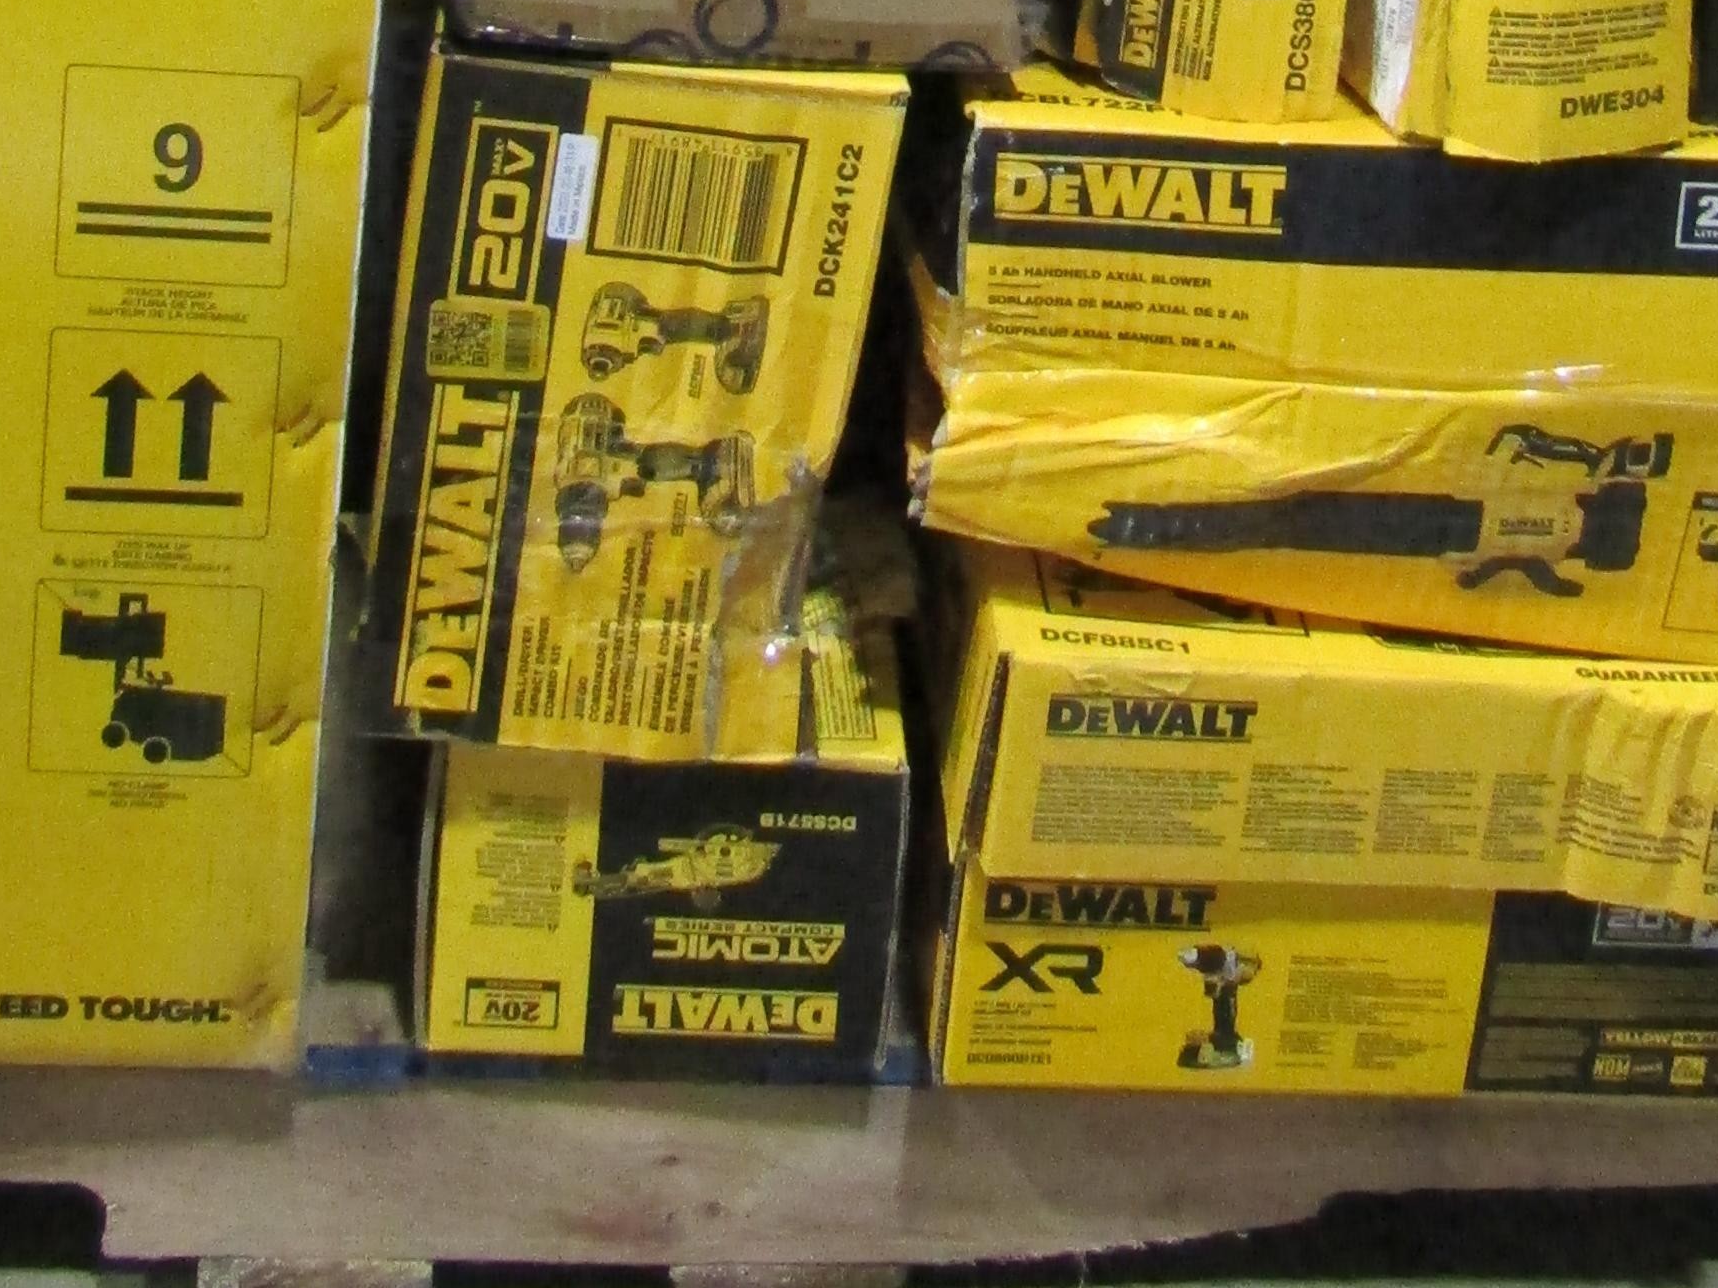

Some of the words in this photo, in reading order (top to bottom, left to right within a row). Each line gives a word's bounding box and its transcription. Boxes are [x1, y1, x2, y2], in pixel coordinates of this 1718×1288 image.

[1560, 85, 1665, 119] DWE304
[153, 122, 205, 193] 9
[995, 162, 1286, 226] DEWALT
[814, 143, 865, 298] DCK241C2
[1023, 267, 1102, 281] HANDHELD
[1105, 271, 1146, 284] AXIAL
[1151, 274, 1212, 288] BLOWER
[406, 383, 512, 712] DEWALT
[1039, 627, 1191, 655] DCF885C1
[1046, 697, 1258, 739] DEWALT
[985, 884, 1216, 927] DEWALT
[653, 936, 845, 964] ATOMIC
[979, 941, 1106, 994] XR
[613, 989, 838, 1035] DEWALT
